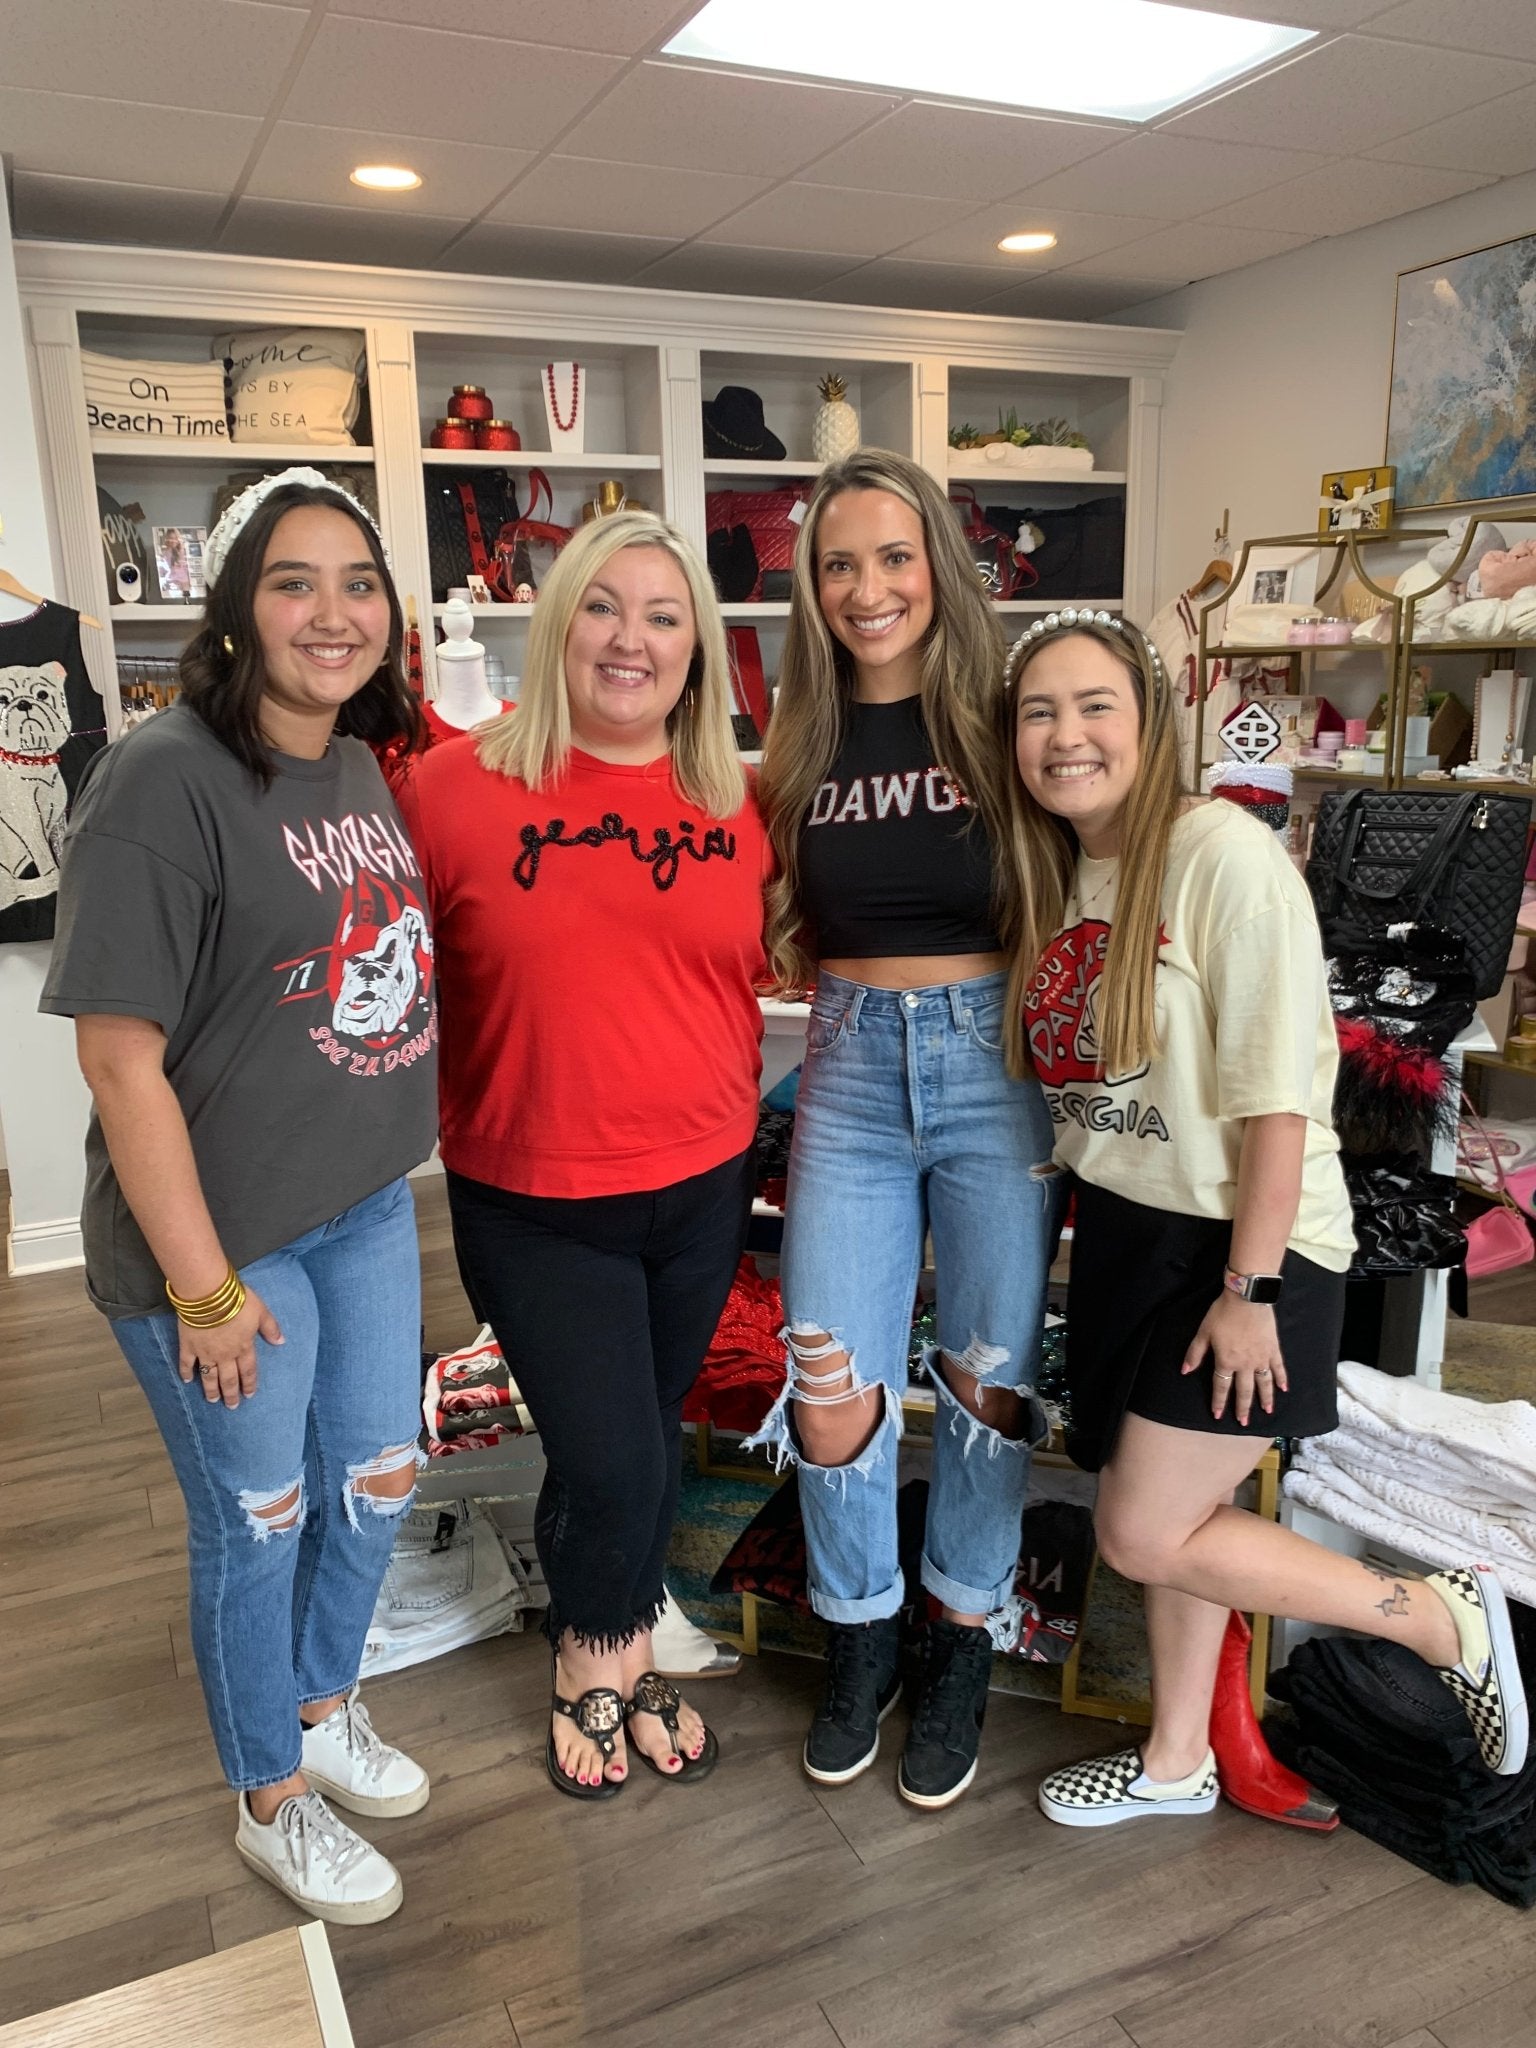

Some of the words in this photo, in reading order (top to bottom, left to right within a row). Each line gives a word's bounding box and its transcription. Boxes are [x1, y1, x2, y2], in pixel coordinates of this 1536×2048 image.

[129, 377, 169, 402] On
[268, 380, 293, 393] BY
[86, 403, 163, 434] Beach
[172, 415, 225, 436] Time
[237, 413, 258, 428] HE
[270, 412, 307, 427] SEA
[808, 769, 978, 826] DAWG
[281, 811, 424, 894] GEORGIA
[513, 812, 736, 891] georgia
[1041, 970, 1073, 1006] THEM
